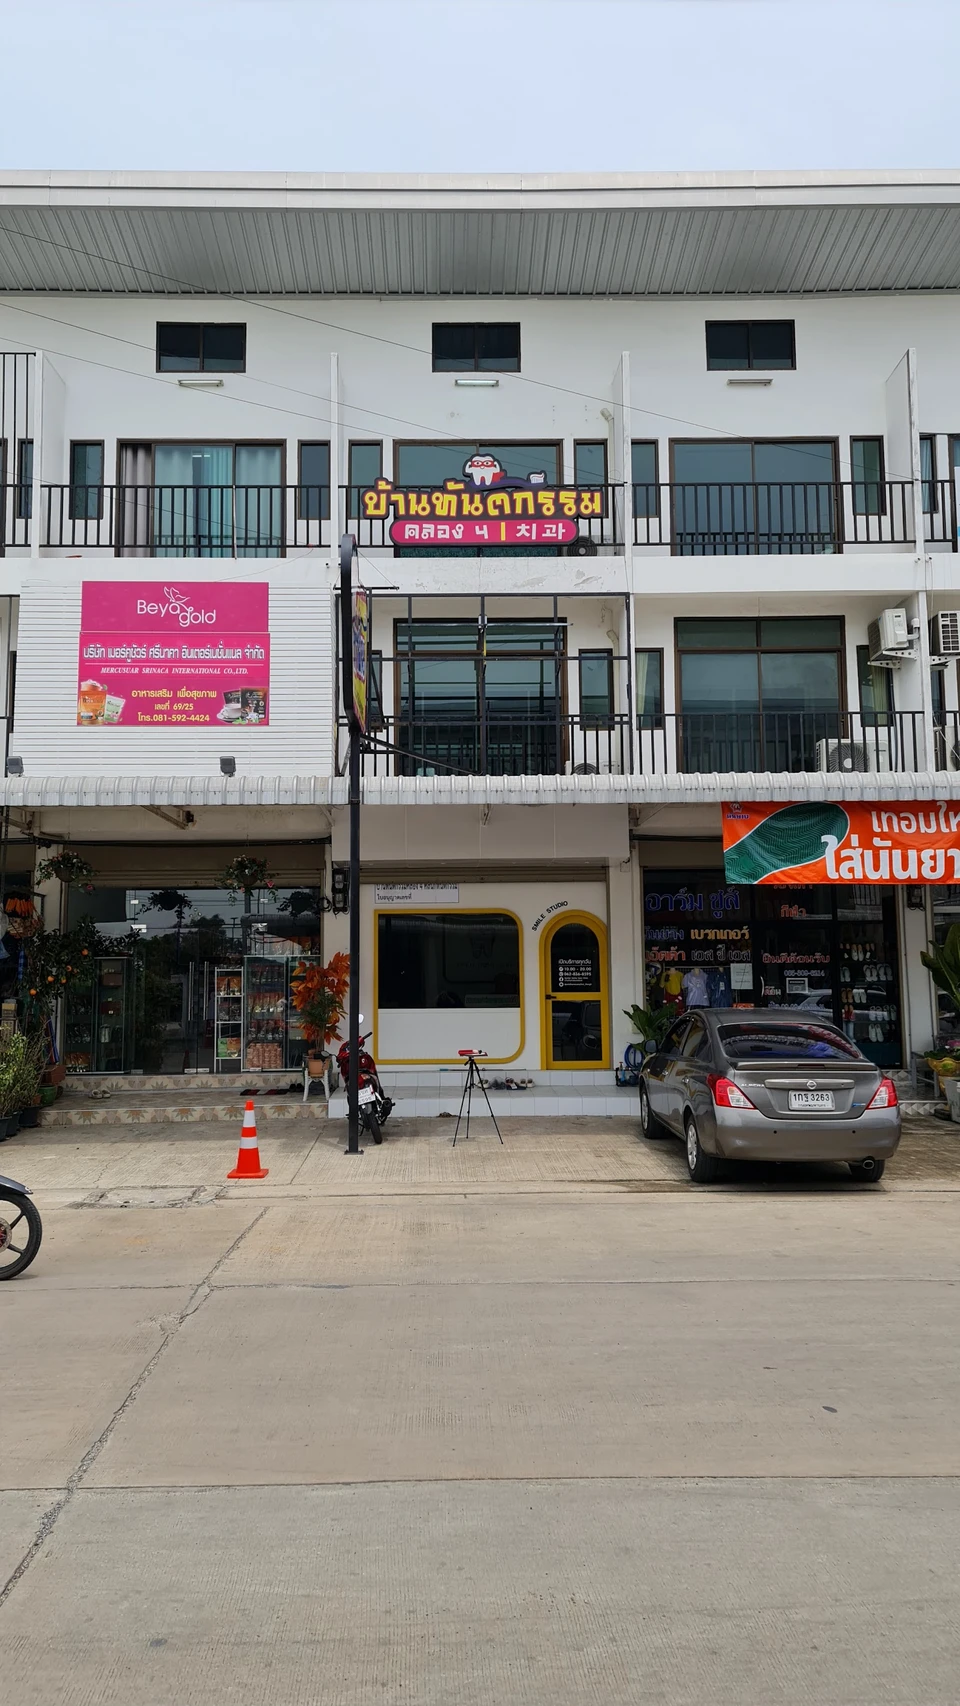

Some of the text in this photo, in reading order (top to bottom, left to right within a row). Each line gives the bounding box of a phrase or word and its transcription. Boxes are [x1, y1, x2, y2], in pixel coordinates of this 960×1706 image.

[363, 480, 602, 517] บ้านทันตกรรม
[404, 523, 464, 540] คลอง
[515, 522, 566, 541] 치과
[136, 599, 216, 627] Beya gold
[83, 644, 106, 659] บริษัท
[148, 645, 179, 660] ศรีนาคา
[181, 640, 242, 660] อินเตอร์เนชั่นแนล
[244, 644, 265, 660] จำกัด
[100, 666, 140, 675] MERCUSUAR
[141, 666, 169, 675] SRINACA
[171, 666, 221, 675] INTERNATIONAL
[131, 688, 173, 698] อาหารเสริม
[176, 686, 217, 701] เพื่อสุขภาพ
[154, 700, 194, 711] เลขที่ 69/25
[137, 711, 211, 722] โทร.081-592-4424
[645, 887, 704, 912] อาร์ม
[531, 900, 568, 931] SMILE STUDIO
[690, 925, 750, 940] เบรกเกอร์
[810, 1093, 830, 1102] 3263
